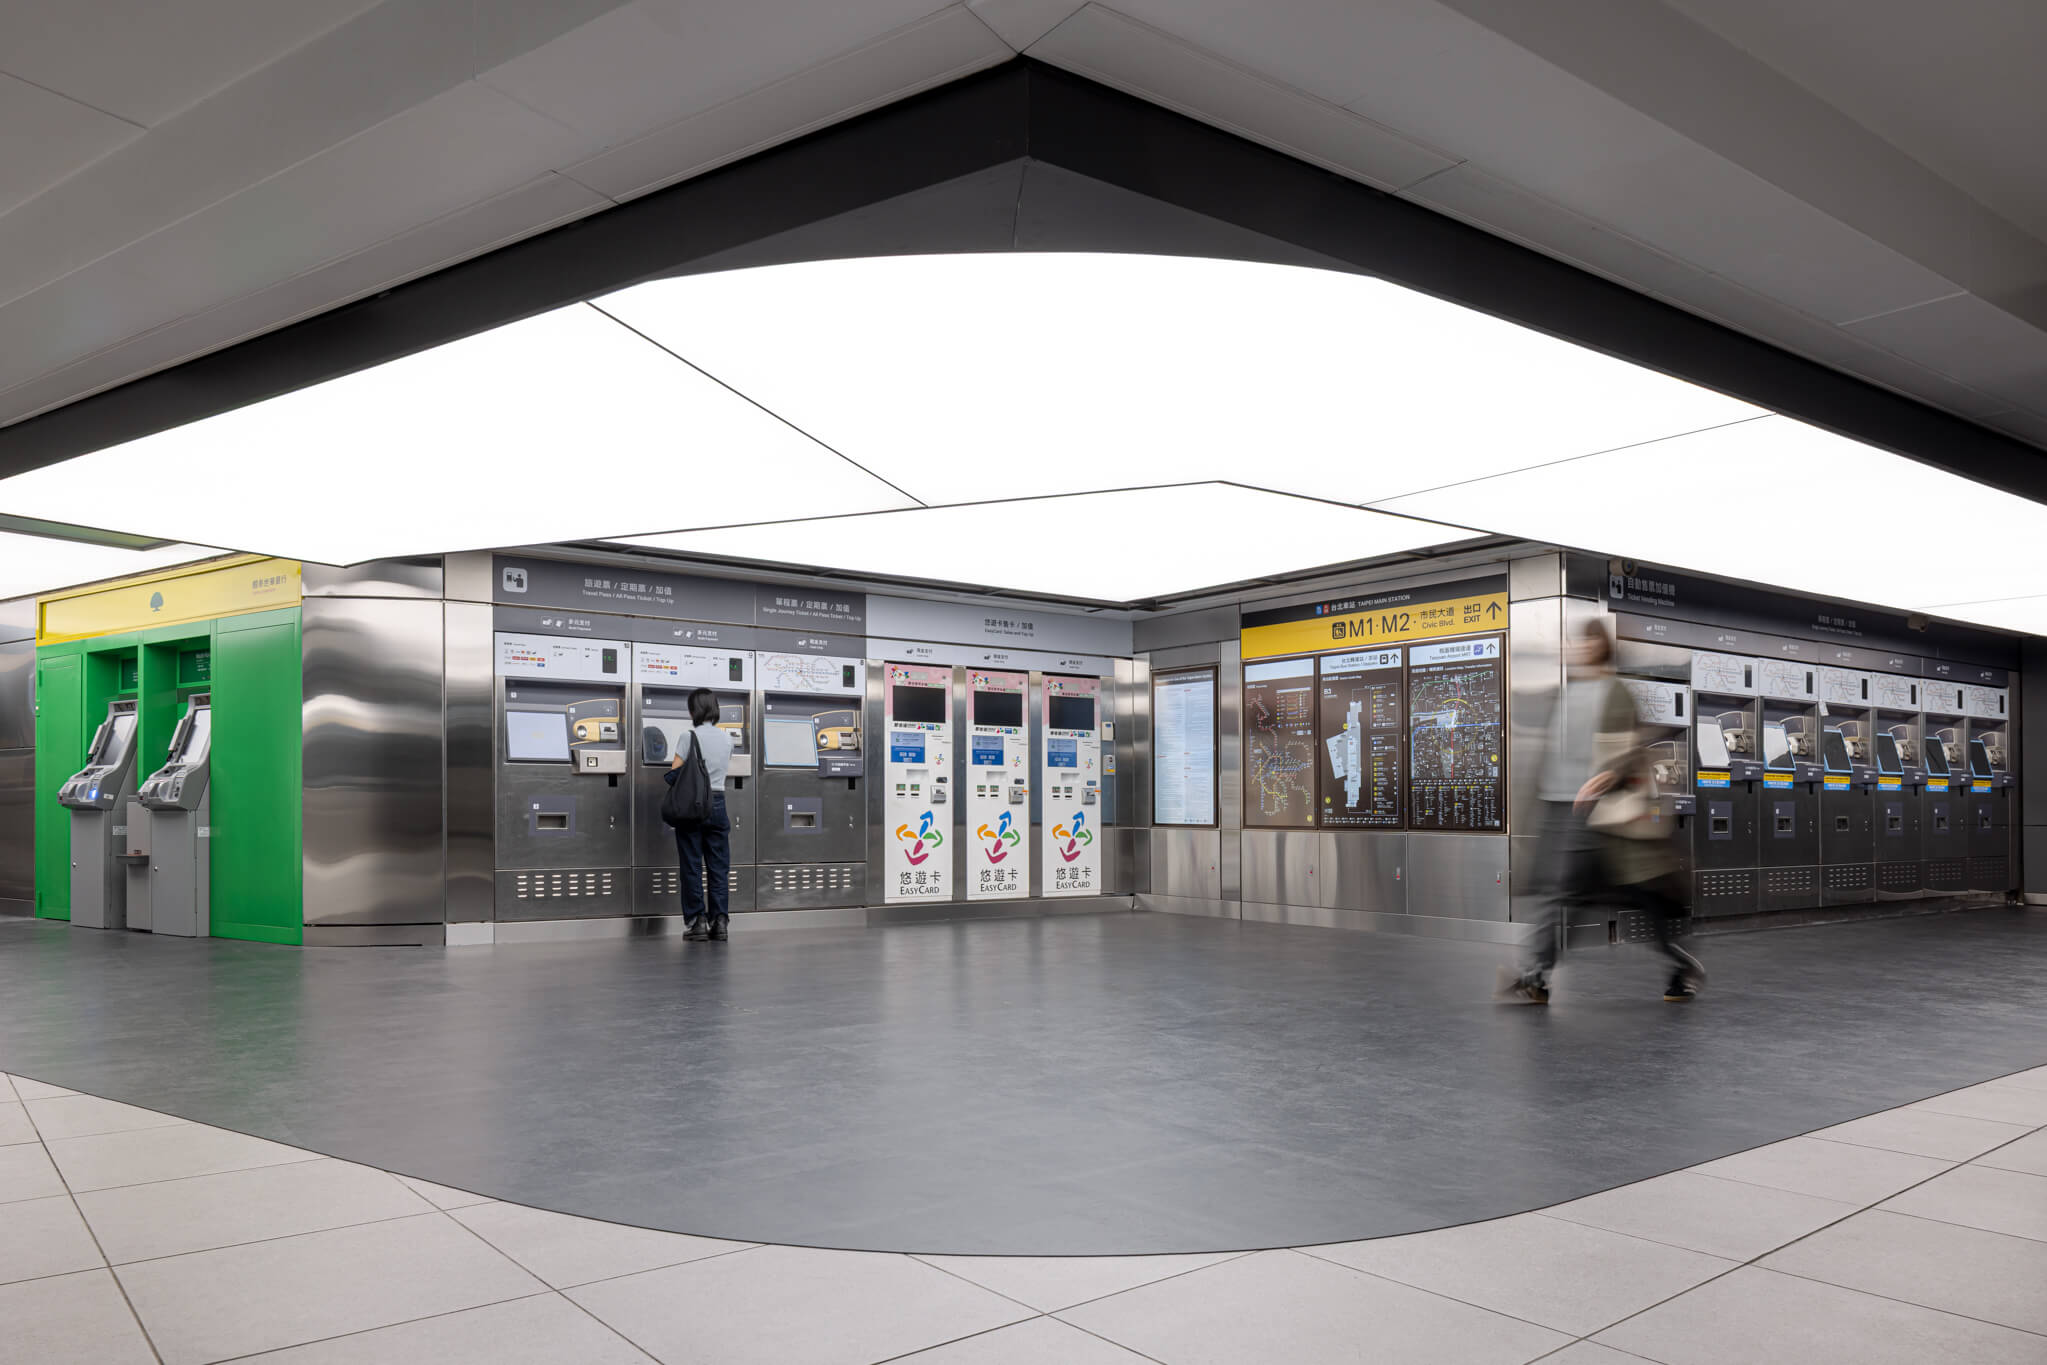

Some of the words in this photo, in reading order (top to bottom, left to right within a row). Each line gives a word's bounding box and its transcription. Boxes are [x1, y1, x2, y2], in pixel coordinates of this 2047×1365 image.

[1358, 599, 1373, 607] TAIPEI
[1388, 595, 1411, 603] STATION
[1420, 606, 1454, 620] 市民大道
[1464, 603, 1480, 614] 出口
[1464, 614, 1480, 623] EXIT
[900, 870, 942, 885] 悠遊卡
[980, 867, 1019, 882] 悠遊卡
[1056, 866, 1092, 880] 悠遊卡
